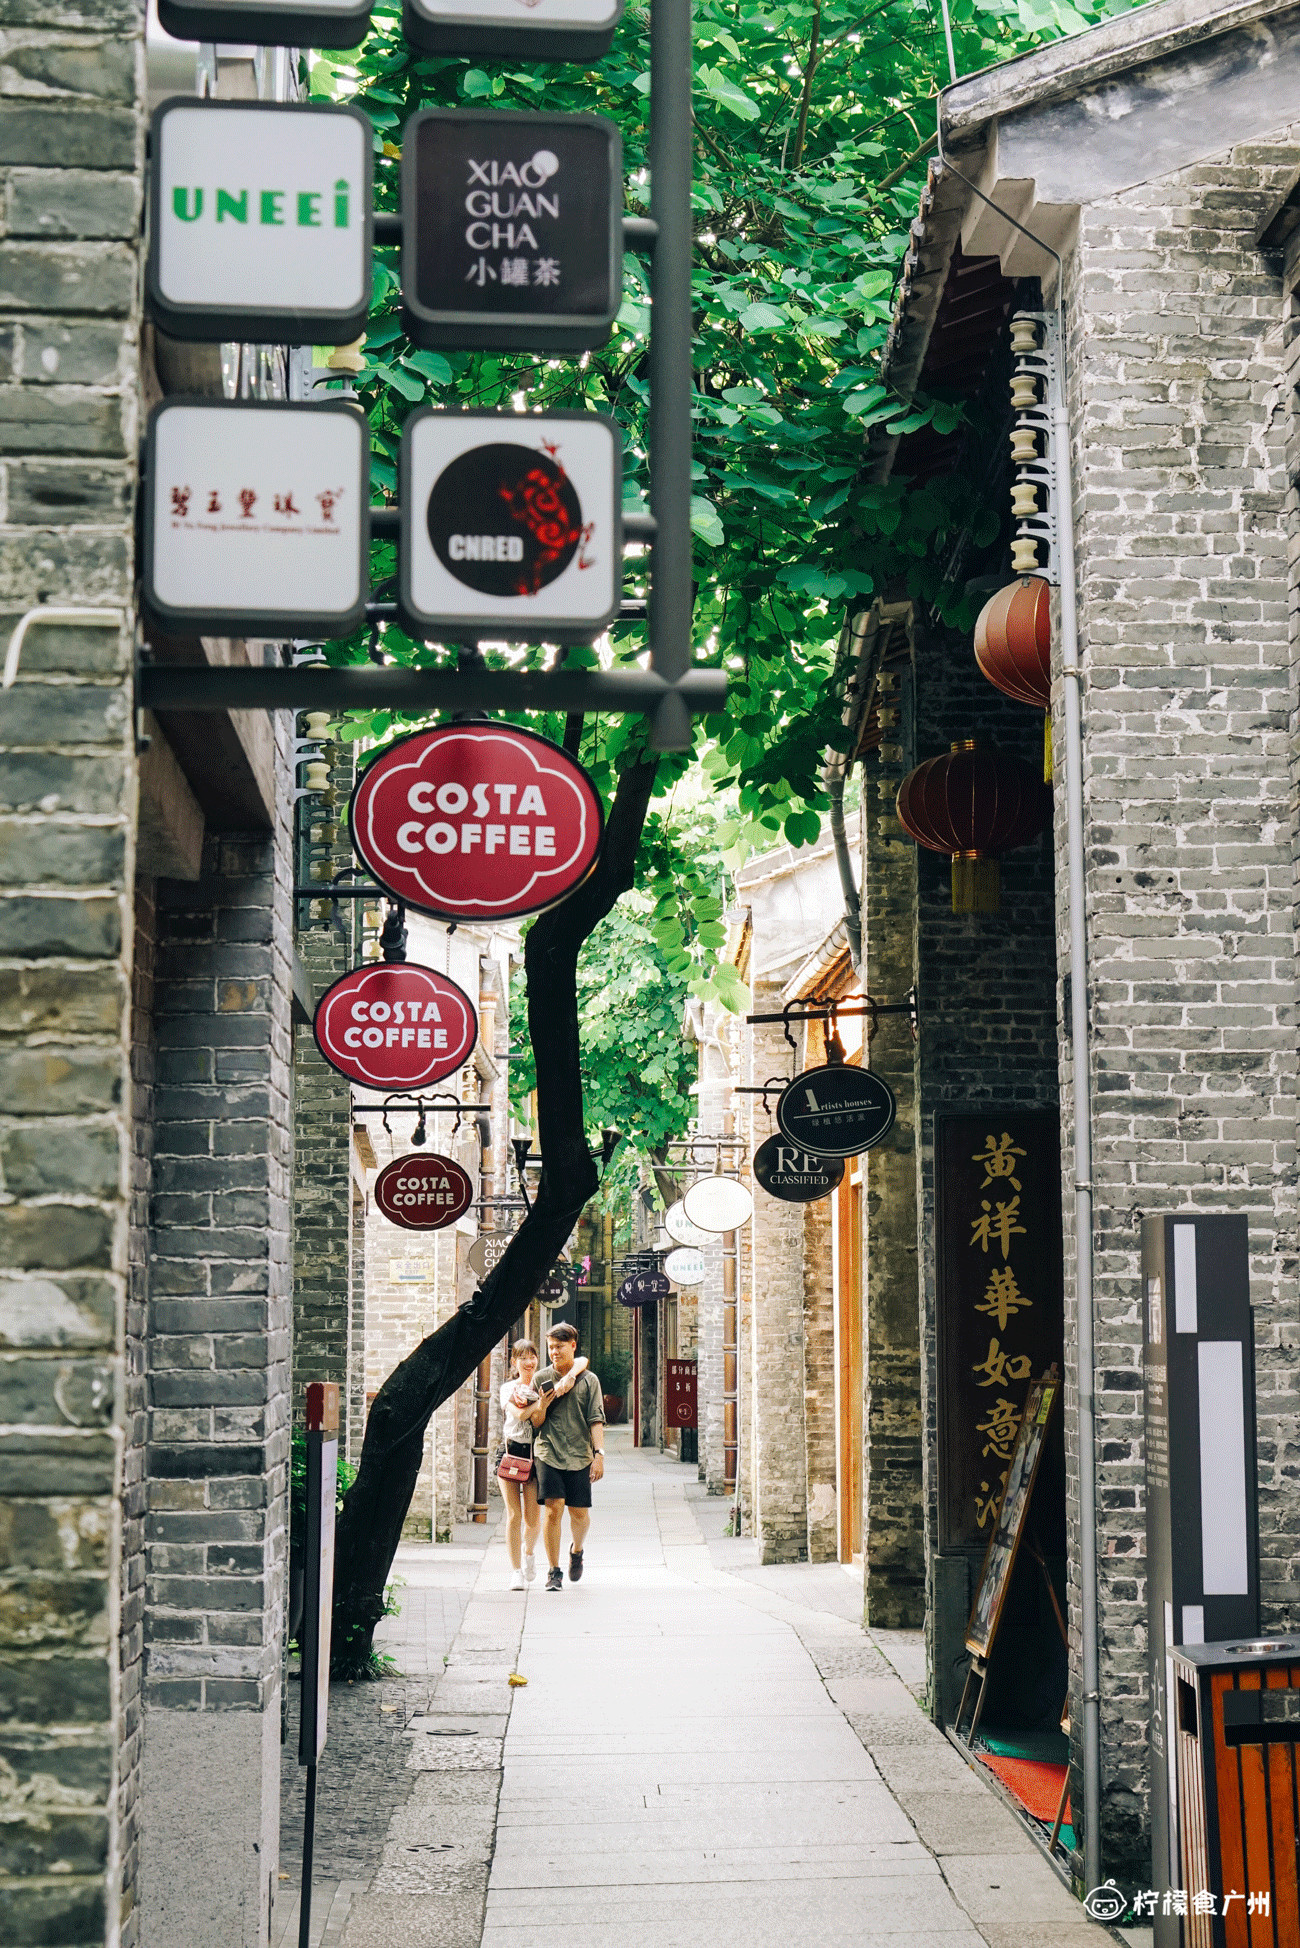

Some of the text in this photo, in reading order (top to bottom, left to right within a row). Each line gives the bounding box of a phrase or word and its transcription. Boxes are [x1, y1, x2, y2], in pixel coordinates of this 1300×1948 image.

[466, 157, 553, 188] XIAO
[465, 190, 559, 219] GUAN
[465, 221, 539, 250] CHA
[464, 256, 561, 287] 小罐茶
[449, 535, 524, 562] CNRED
[407, 781, 548, 818] COSTA
[396, 821, 556, 857] COFFEE
[351, 1001, 442, 1024] COSTA
[344, 1026, 448, 1048] COFFEE
[804, 1089, 872, 1112] Artists houses
[776, 1147, 824, 1173] RE
[396, 1177, 450, 1190] COSTA
[770, 1175, 829, 1185] CLASSIFIED
[392, 1193, 454, 1206] COFFEE
[395, 1261, 430, 1270] 安全出口
